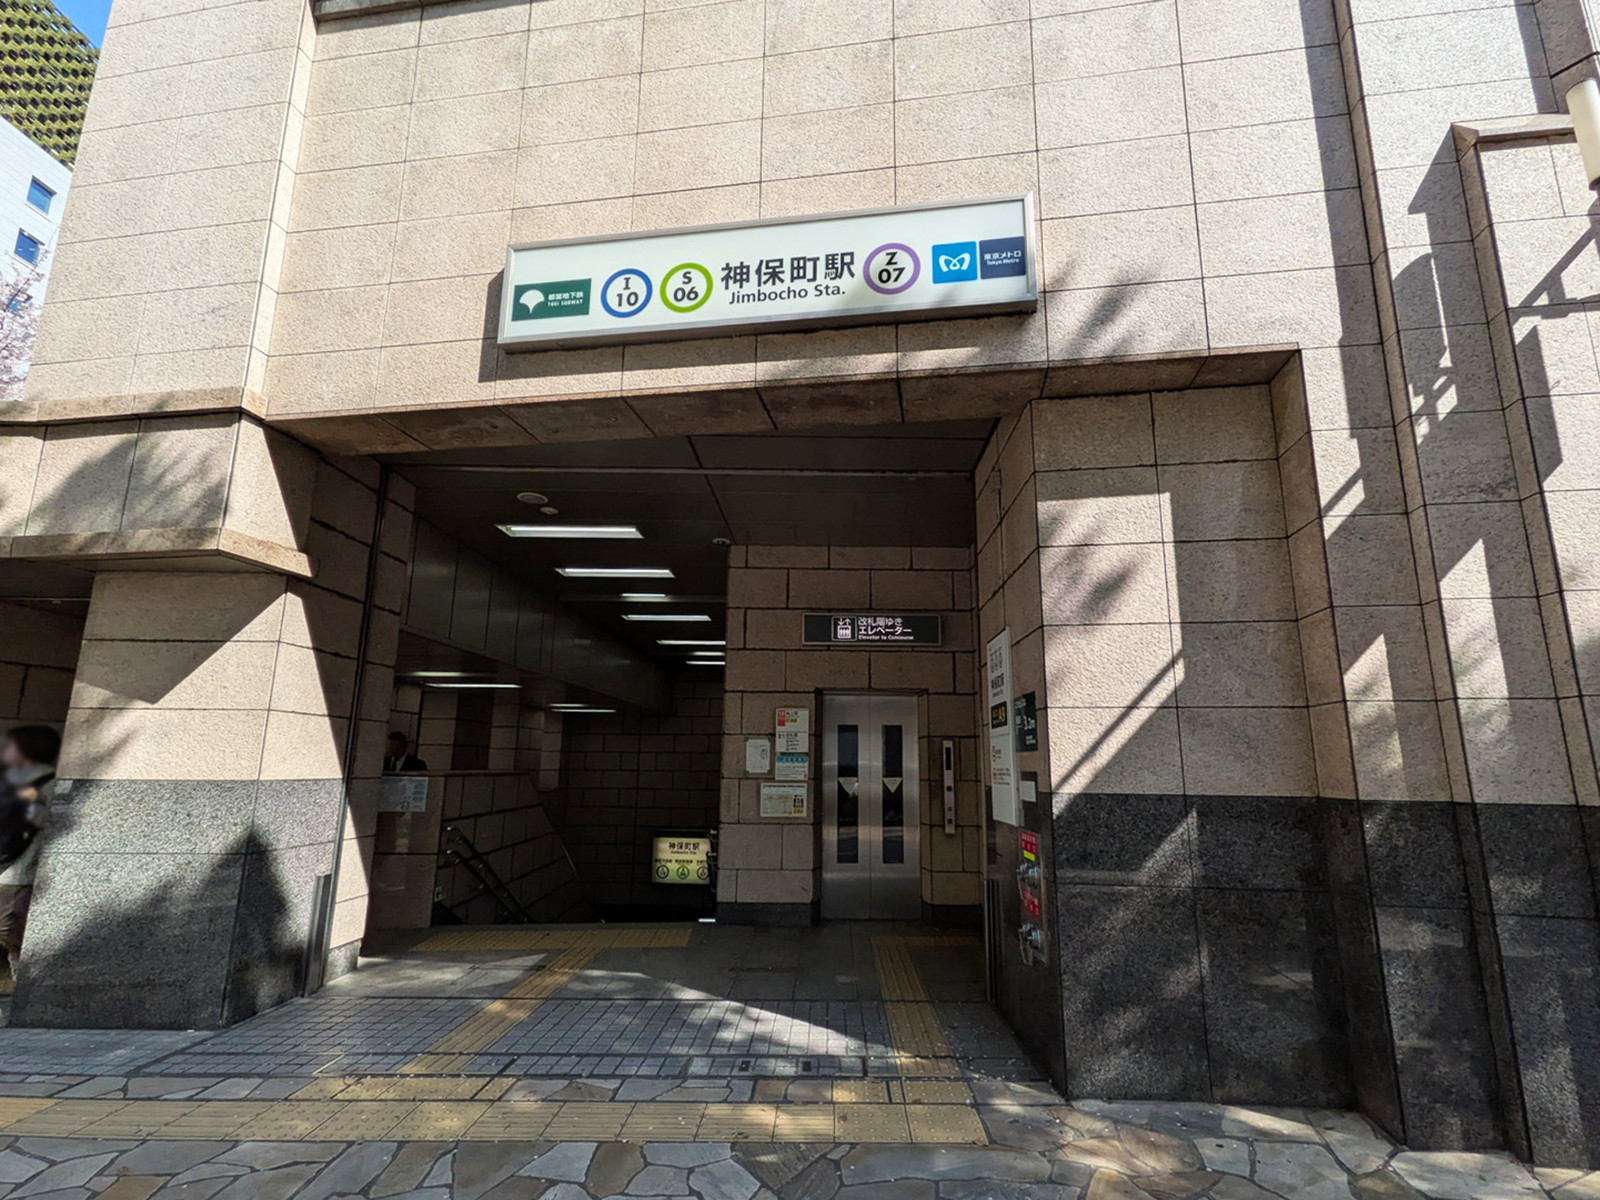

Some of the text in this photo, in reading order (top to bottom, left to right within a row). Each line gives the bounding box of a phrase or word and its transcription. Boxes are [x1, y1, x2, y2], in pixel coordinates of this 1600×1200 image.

[885, 252, 898, 266] Z
[983, 250, 1022, 261] 東京メトロ
[681, 271, 692, 285] S
[721, 251, 855, 290] 神保町駅
[877, 267, 906, 284] 07
[616, 291, 639, 307] 10
[673, 286, 699, 302] 06
[729, 284, 846, 306] Jimbocho Sta.
[858, 616, 904, 627] 改札階ゆき
[858, 626, 912, 635] エレベーター
